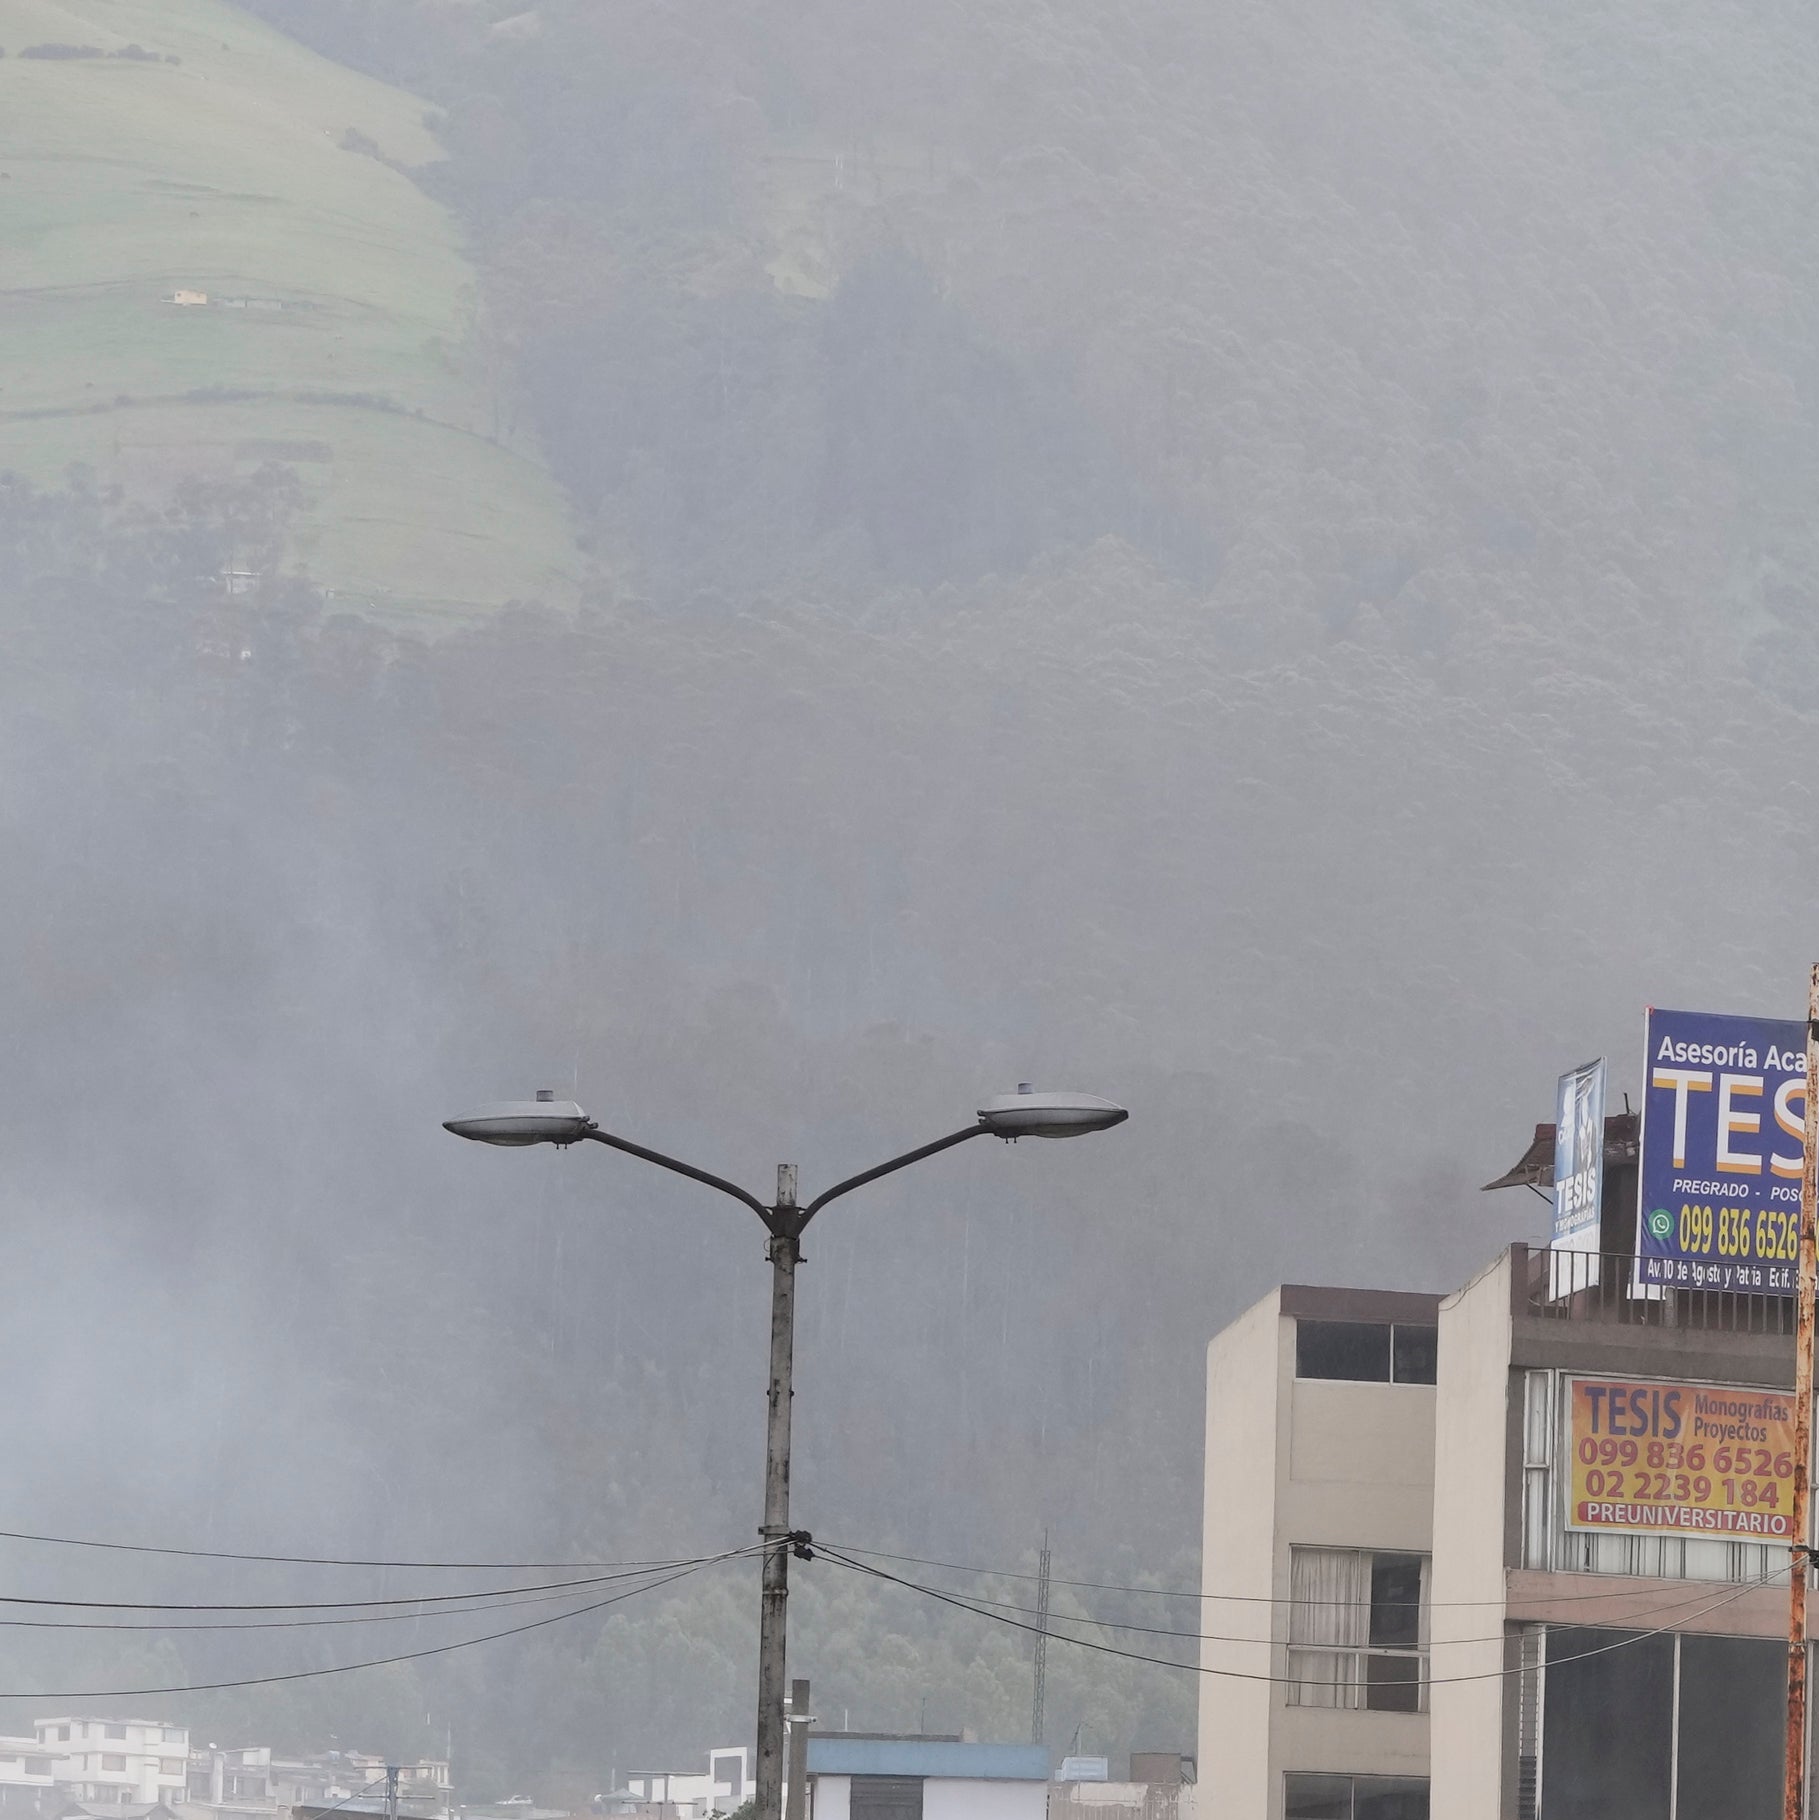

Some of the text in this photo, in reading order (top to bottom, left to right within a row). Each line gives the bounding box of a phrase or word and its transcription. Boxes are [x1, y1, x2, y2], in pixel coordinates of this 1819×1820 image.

[1656, 1035, 1758, 1069] Asesoría
[1556, 1167, 1596, 1215] TESIS
[1672, 1178, 1749, 1198] PREGRADO
[1679, 1203, 1713, 1254] 099
[1717, 1207, 1751, 1257] 836
[1755, 1210, 1799, 1261] 6526
[1584, 1387, 1682, 1439] TESIS
[1694, 1416, 1768, 1444] Proyectos
[1578, 1437, 1793, 1478] 099 836 6526
[1586, 1469, 1780, 1508] 02 2239 184
[1587, 1502, 1787, 1535] PREUNIVERSITARIO
